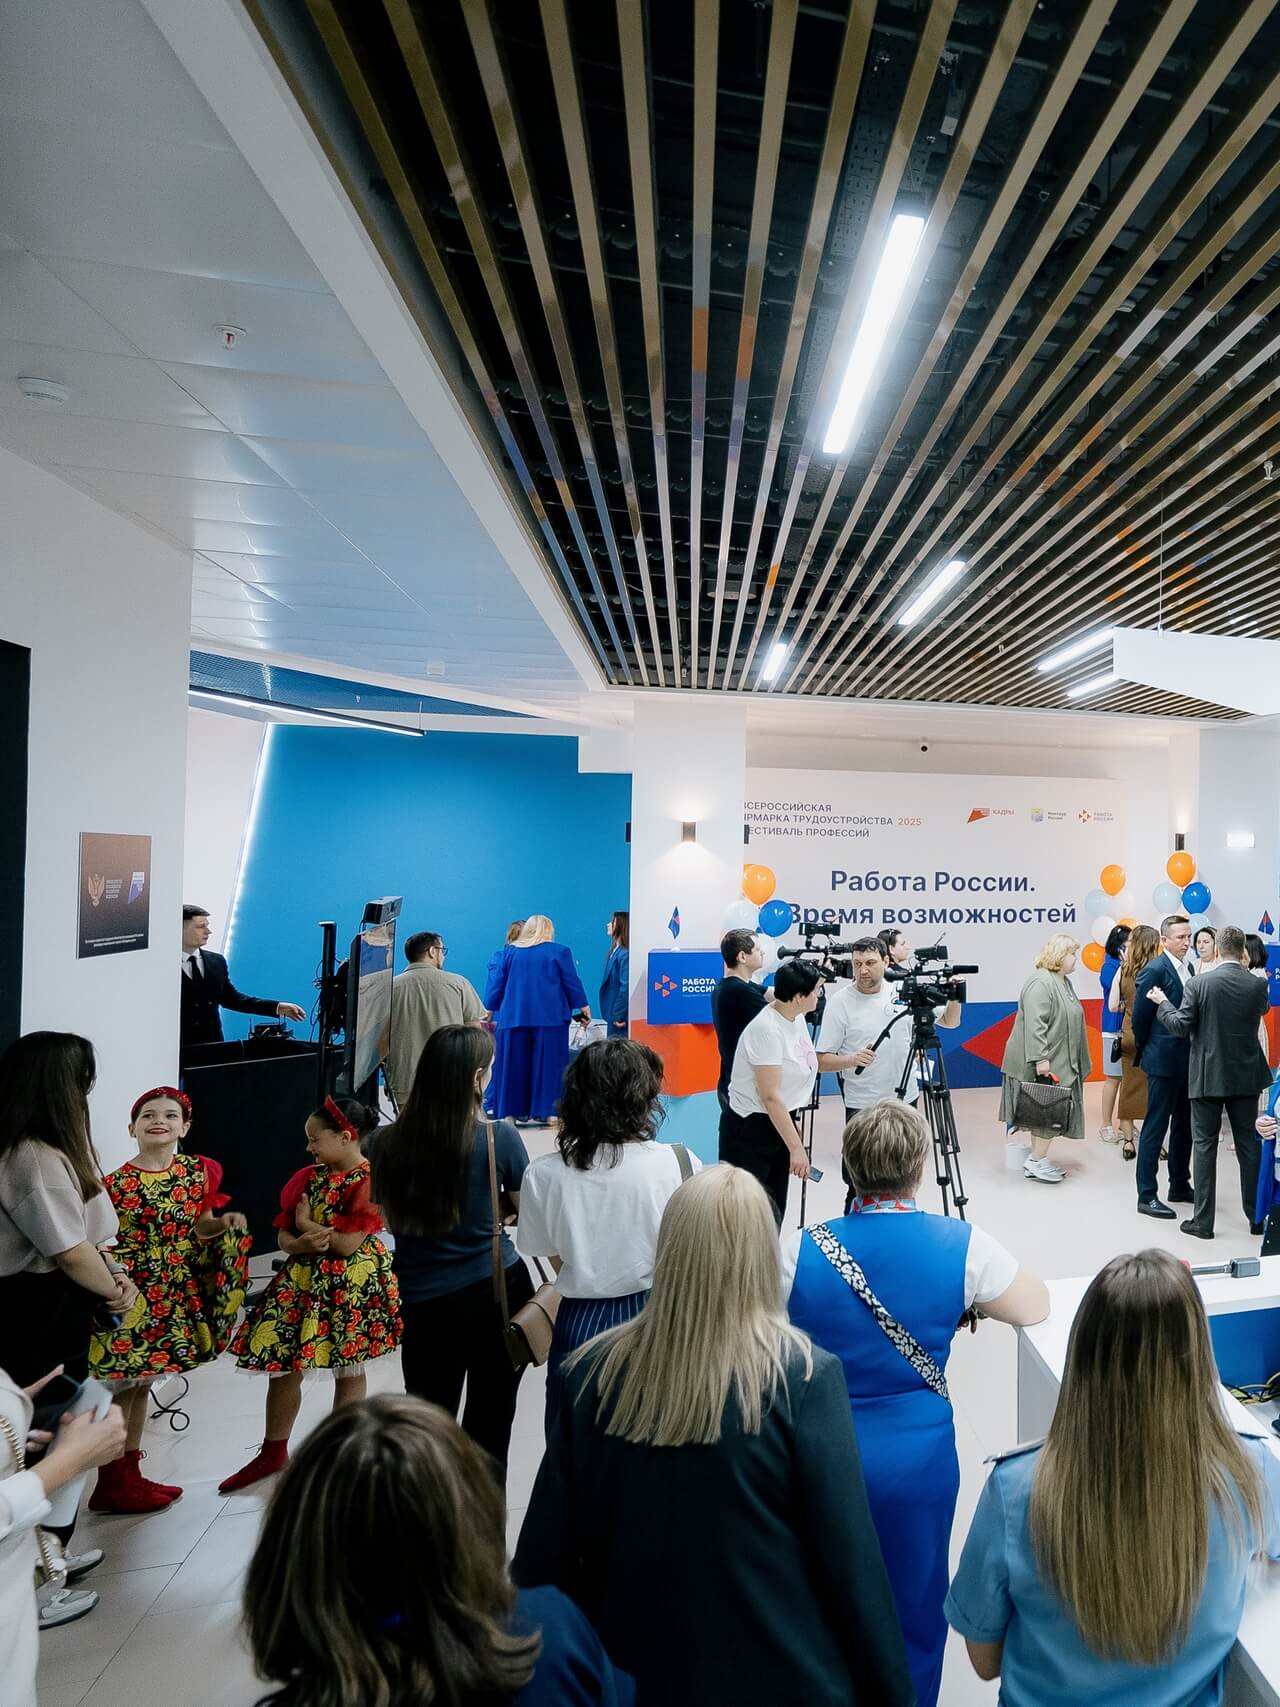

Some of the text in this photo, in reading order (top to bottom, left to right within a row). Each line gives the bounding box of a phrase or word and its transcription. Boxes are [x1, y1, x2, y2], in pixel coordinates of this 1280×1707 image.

[793, 815, 893, 826] ТРУДОУСТРОЙСТВА
[897, 817, 922, 826] 2025
[749, 826, 870, 838] ЕСТИВАЛЬ ПРОФЕССИЙ
[831, 870, 1036, 892] Работа России.
[882, 904, 1076, 924] возможностей
